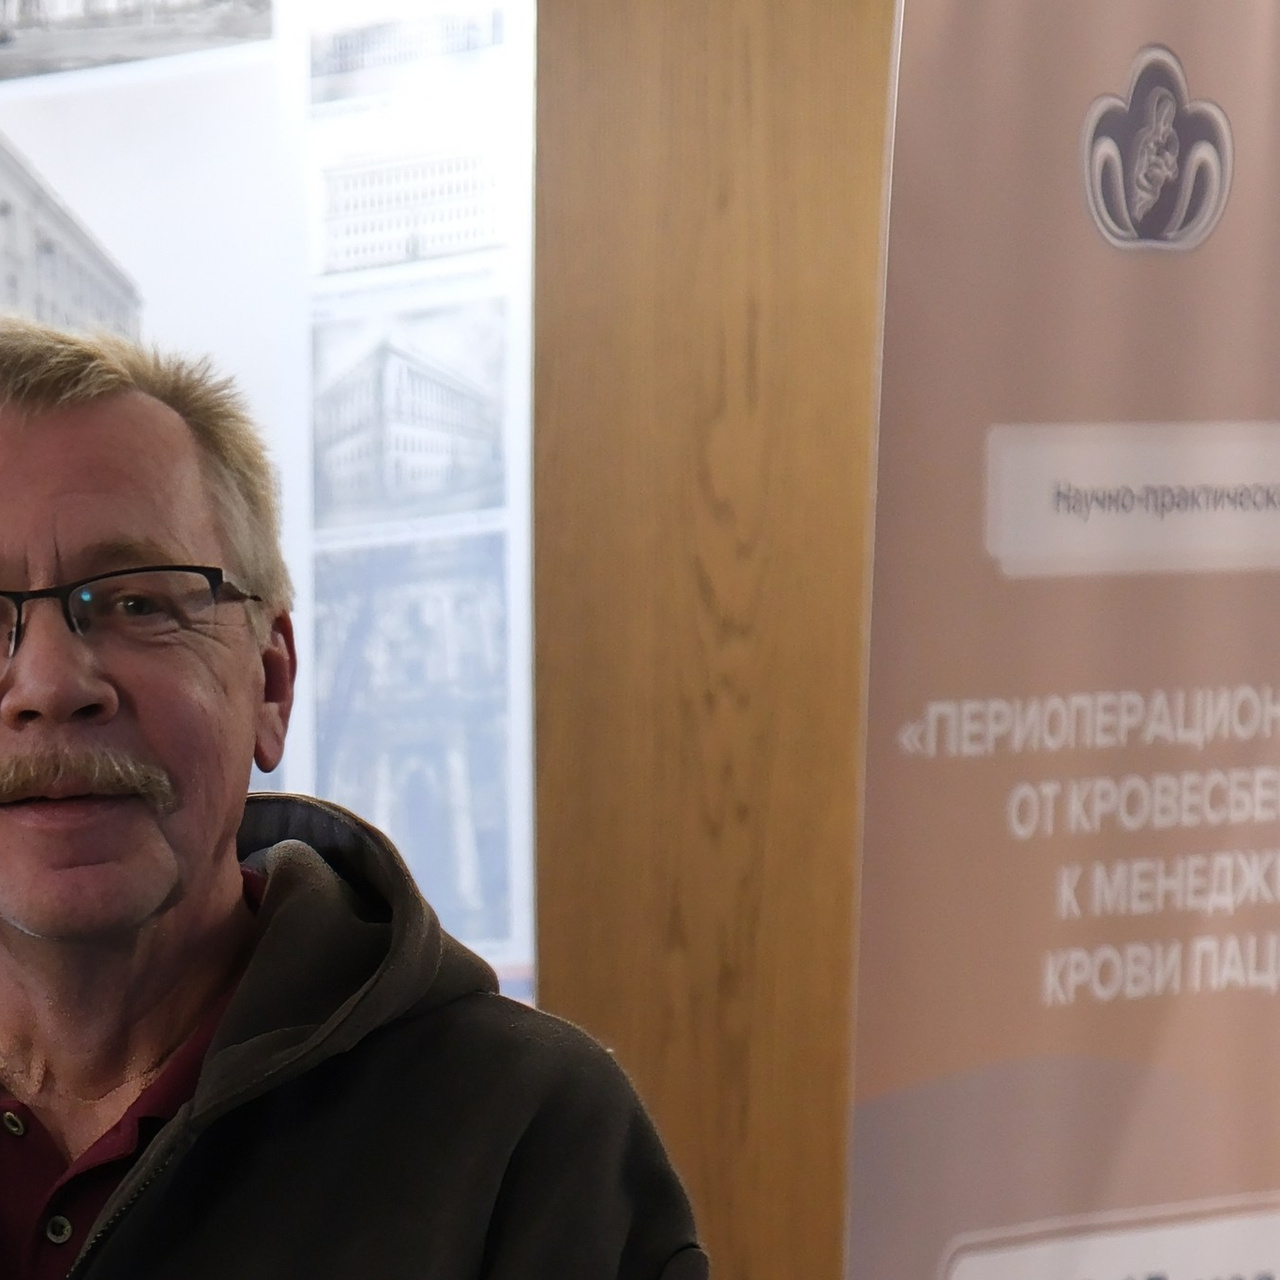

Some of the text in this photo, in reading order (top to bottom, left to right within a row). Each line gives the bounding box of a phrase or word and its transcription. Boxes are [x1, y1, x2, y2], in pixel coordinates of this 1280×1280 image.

[1008, 782, 1060, 839] ОТ
[1057, 852, 1280, 918] К МЕНЕДЖ
[1042, 944, 1181, 1005] КРОВИ
